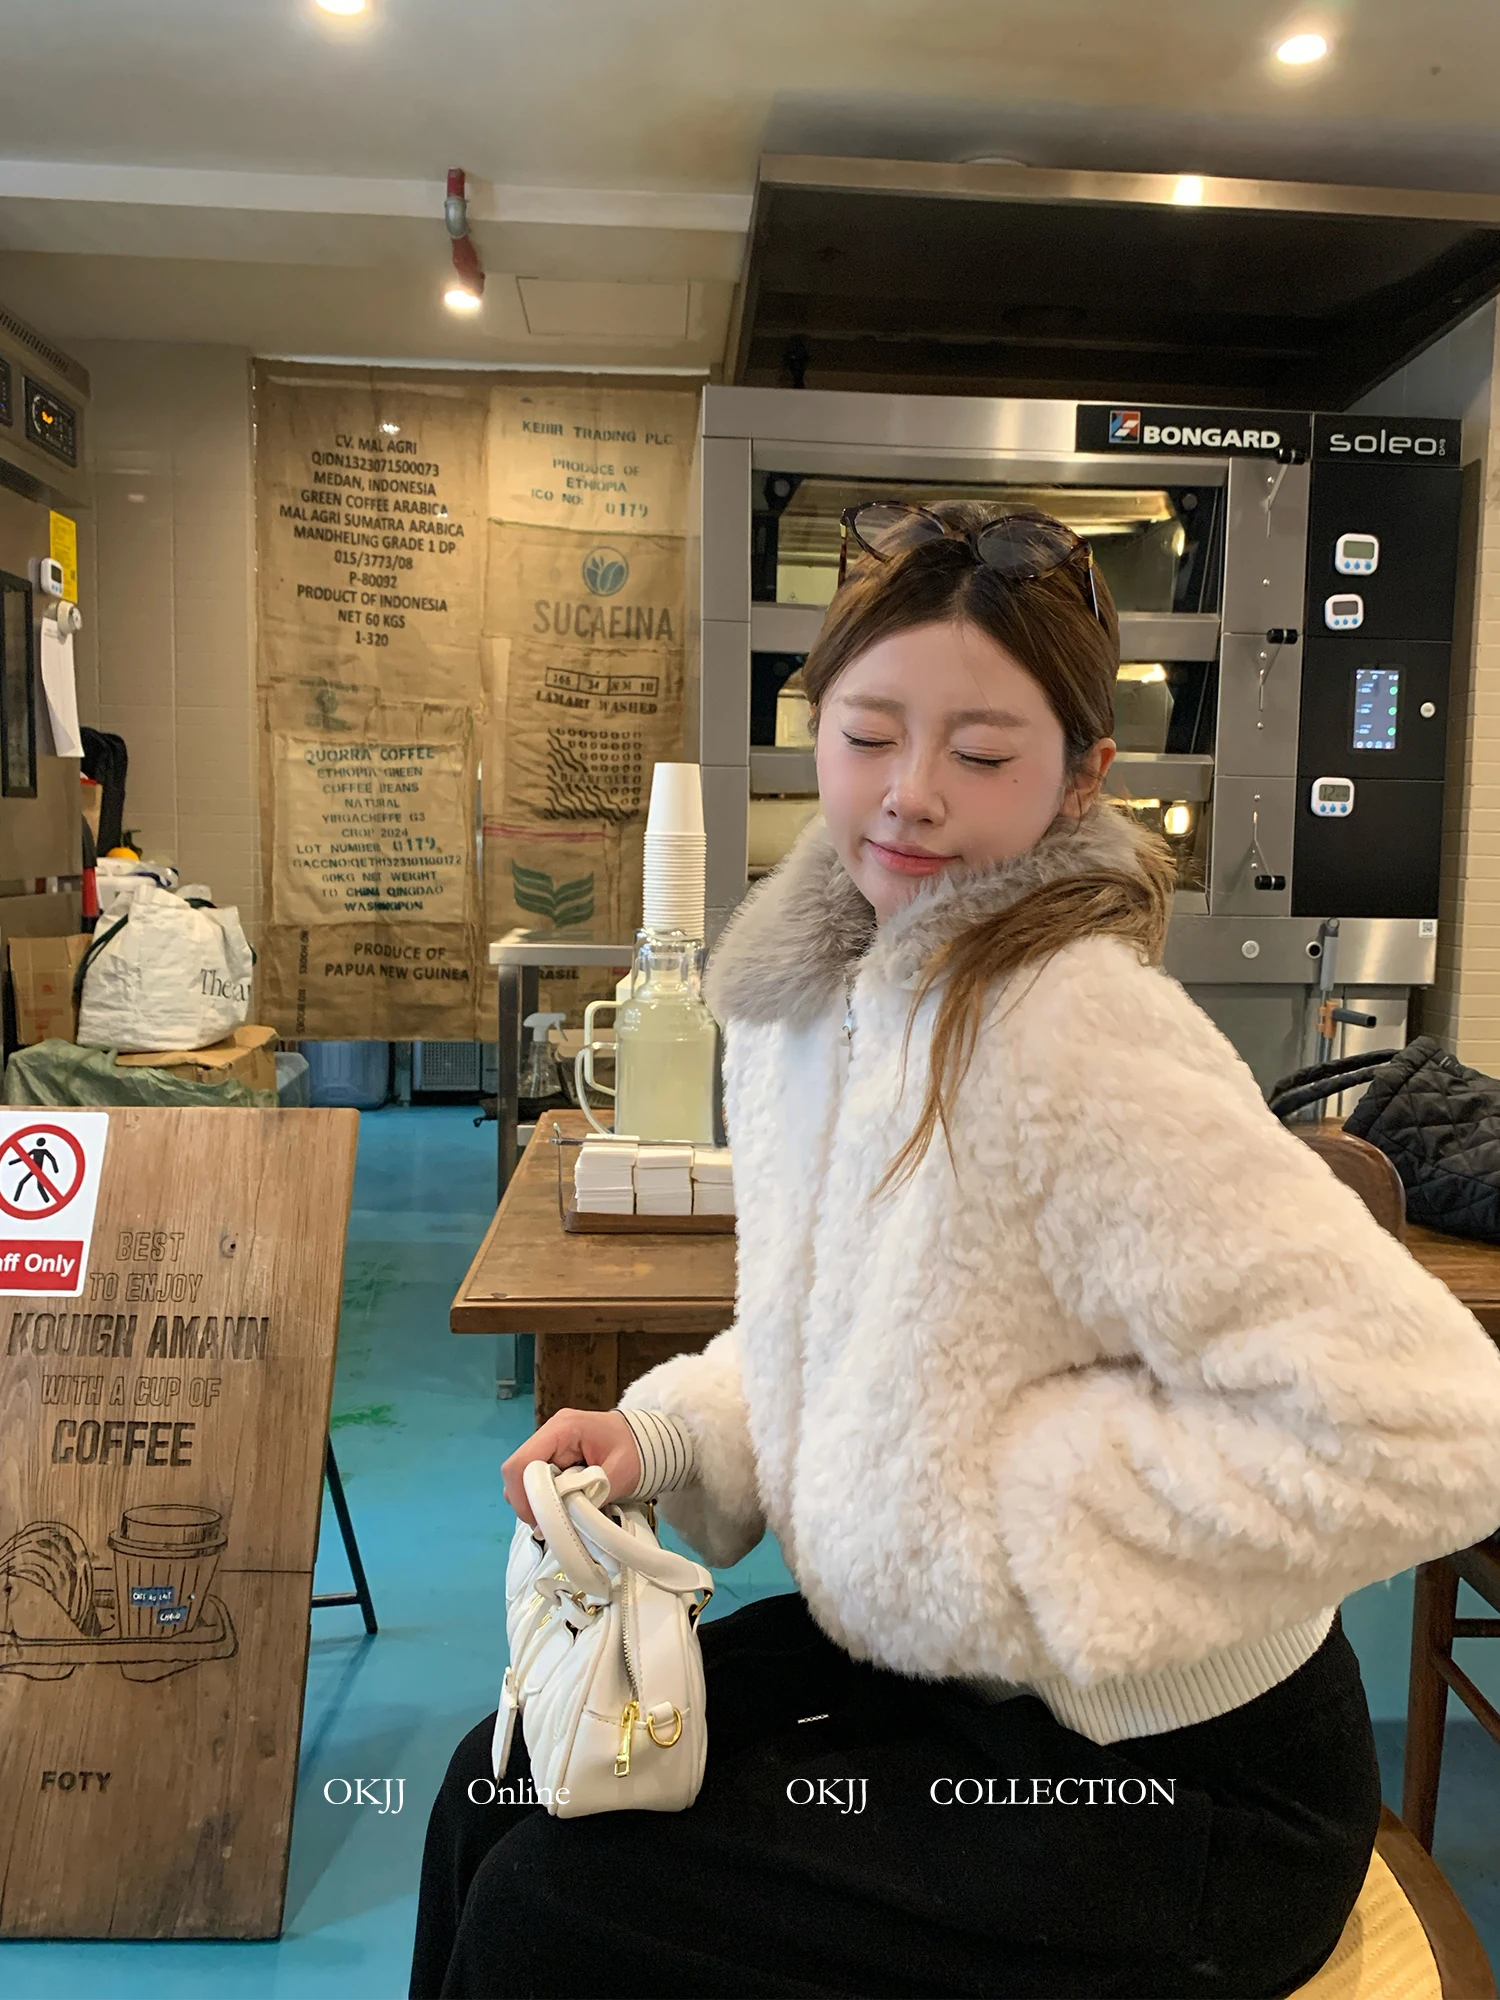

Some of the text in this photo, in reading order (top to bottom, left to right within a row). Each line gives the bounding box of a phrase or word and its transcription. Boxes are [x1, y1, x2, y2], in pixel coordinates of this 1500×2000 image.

[335, 434, 417, 455] CV. MAL AGRI
[573, 426, 636, 442] TRADING
[645, 432, 674, 446] PLC
[1143, 426, 1281, 449] BONGARD
[1329, 428, 1437, 456] soleo
[553, 458, 640, 476] PRODUCE OF
[314, 471, 436, 497] MEDAN, INDONESIA
[566, 477, 627, 493] ETHIOPIA
[301, 489, 448, 515] GREEN COFFEE ARABICA
[531, 488, 553, 501] ICO
[280, 504, 464, 537] MAL AGRI SUMATRA ARABICA
[294, 526, 379, 548] MANDHELING
[382, 536, 424, 551] GRADE
[428, 538, 434, 552] 1
[334, 549, 413, 570] 015/3773/08
[350, 572, 398, 588] P-80092
[297, 584, 448, 612] PRODUCT OF INDONESIA
[338, 609, 406, 629] NET 60 KGS
[355, 631, 389, 647] 1-320
[599, 700, 658, 715] WASHED
[304, 746, 436, 766] QUORRA COFFEE
[317, 766, 423, 778] ETHIOPIA GREEN
[322, 782, 420, 794] COFFEE BEANS
[344, 798, 400, 809] NATURAL
[410, 812, 426, 822] G3
[342, 828, 409, 838] CROP 2024
[296, 844, 322, 854] LOT
[330, 843, 382, 854] NUMBER
[362, 872, 382, 882] NET
[390, 870, 438, 882] WEIGHT
[322, 886, 444, 898] TO CHINA QINGDAO
[354, 942, 446, 961] PRODUCE OF
[324, 963, 470, 982] PAPUA NEW GUINEA
[539, 969, 580, 980] RASIL
[116, 1231, 185, 1262] BEST
[0, 1253, 76, 1278] ff Only
[90, 1273, 203, 1303] TO ENJOY
[6, 1312, 269, 1361] KOUIGN AMANN
[41, 1374, 222, 1408] WITH A CUP OF
[52, 1419, 196, 1467] COFFEE
[40, 1771, 113, 1793] FOTY
